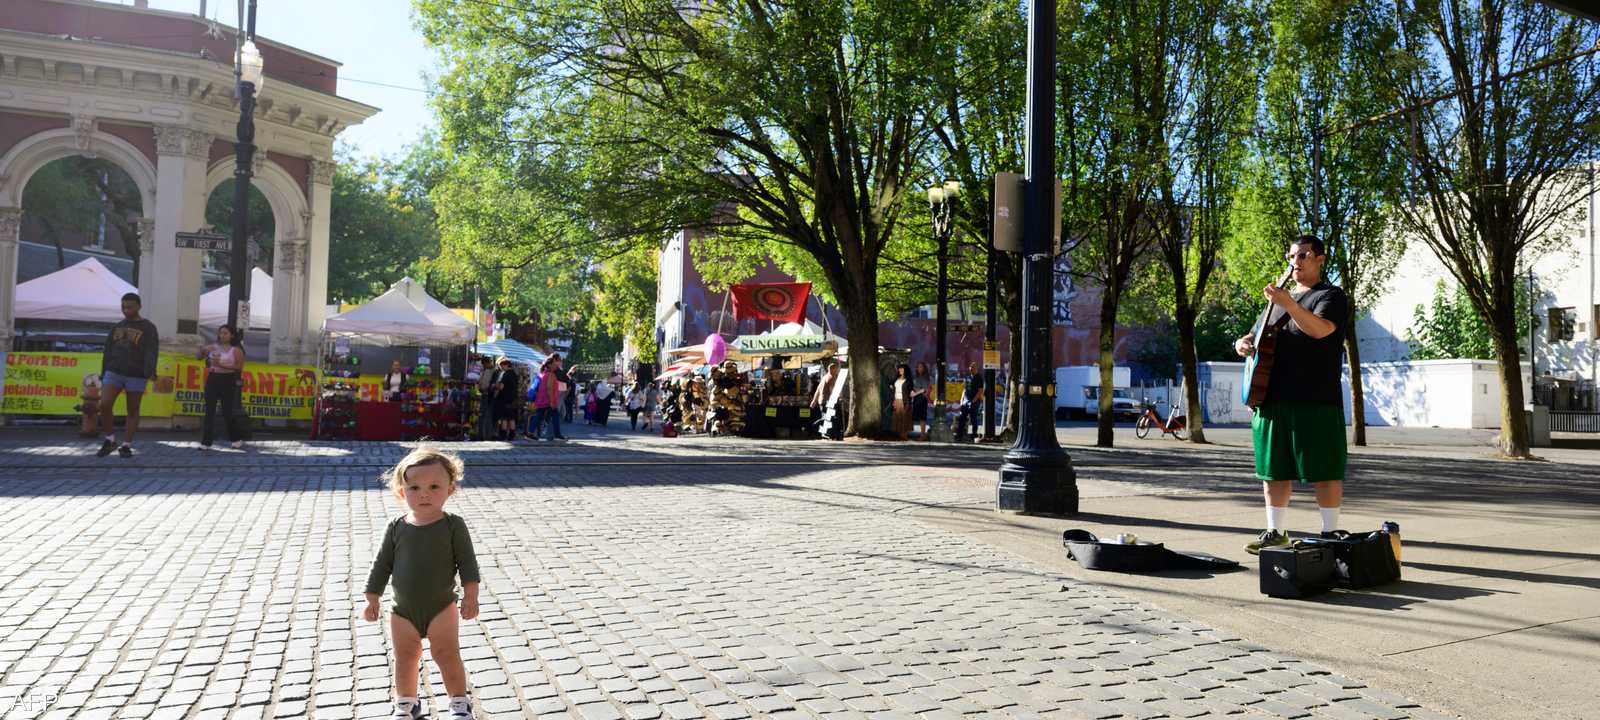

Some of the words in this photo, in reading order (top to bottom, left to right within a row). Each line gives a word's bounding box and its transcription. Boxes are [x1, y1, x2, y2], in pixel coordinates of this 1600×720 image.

[193, 239, 210, 248] FIRST
[741, 337, 821, 349] SUNGLASSES
[17, 354, 48, 366] Pork
[52, 355, 78, 367] Bao
[176, 362, 288, 395] LEANT
[55, 384, 78, 396] Bao
[249, 395, 277, 405] CURLY
[248, 406, 292, 417] LEMONADE
